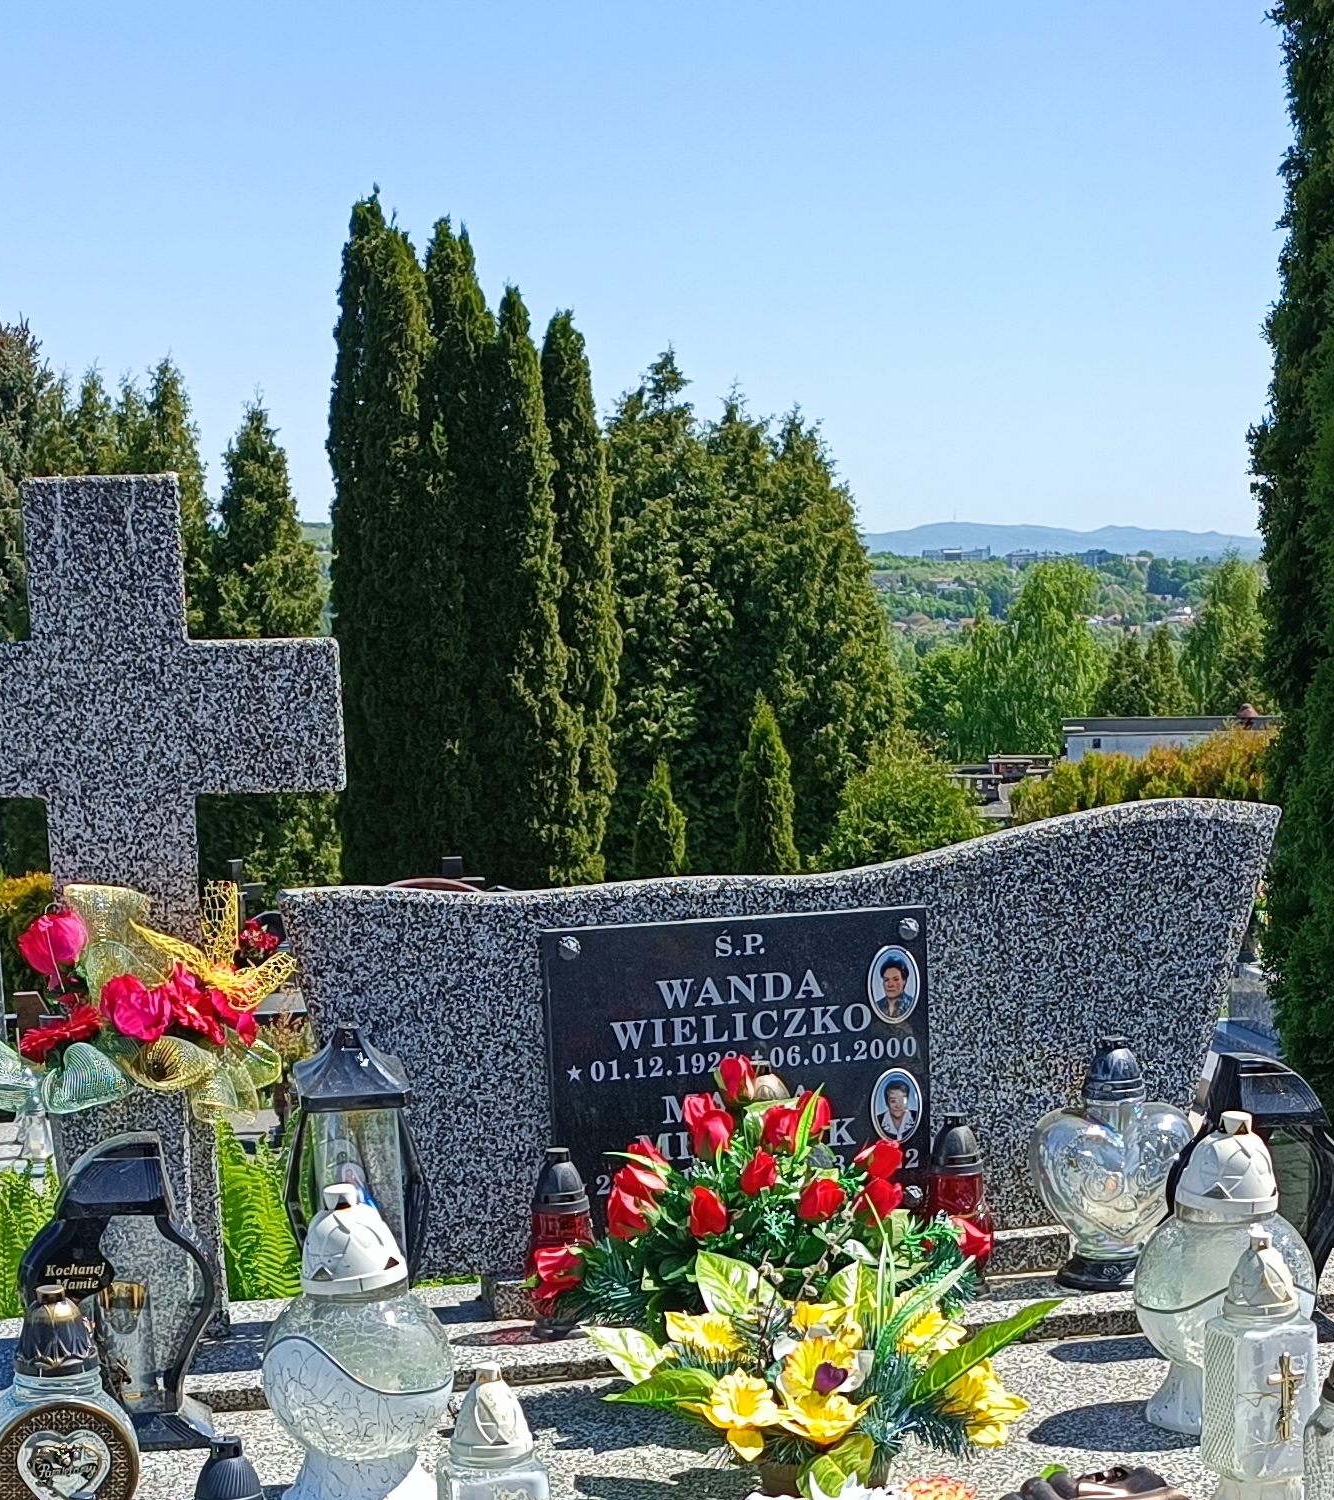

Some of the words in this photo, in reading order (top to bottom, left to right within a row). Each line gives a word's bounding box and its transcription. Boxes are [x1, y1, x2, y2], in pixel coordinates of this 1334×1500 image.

[715, 929, 765, 957] Ś.P.
[655, 968, 825, 1010] WANDA
[609, 1003, 872, 1051] WIELICZKO
[590, 1050, 738, 1082] 01.12.192
[770, 1036, 917, 1068] 06.01.2000
[44, 1261, 106, 1277] Kochanej
[56, 1277, 99, 1291] Mamie
